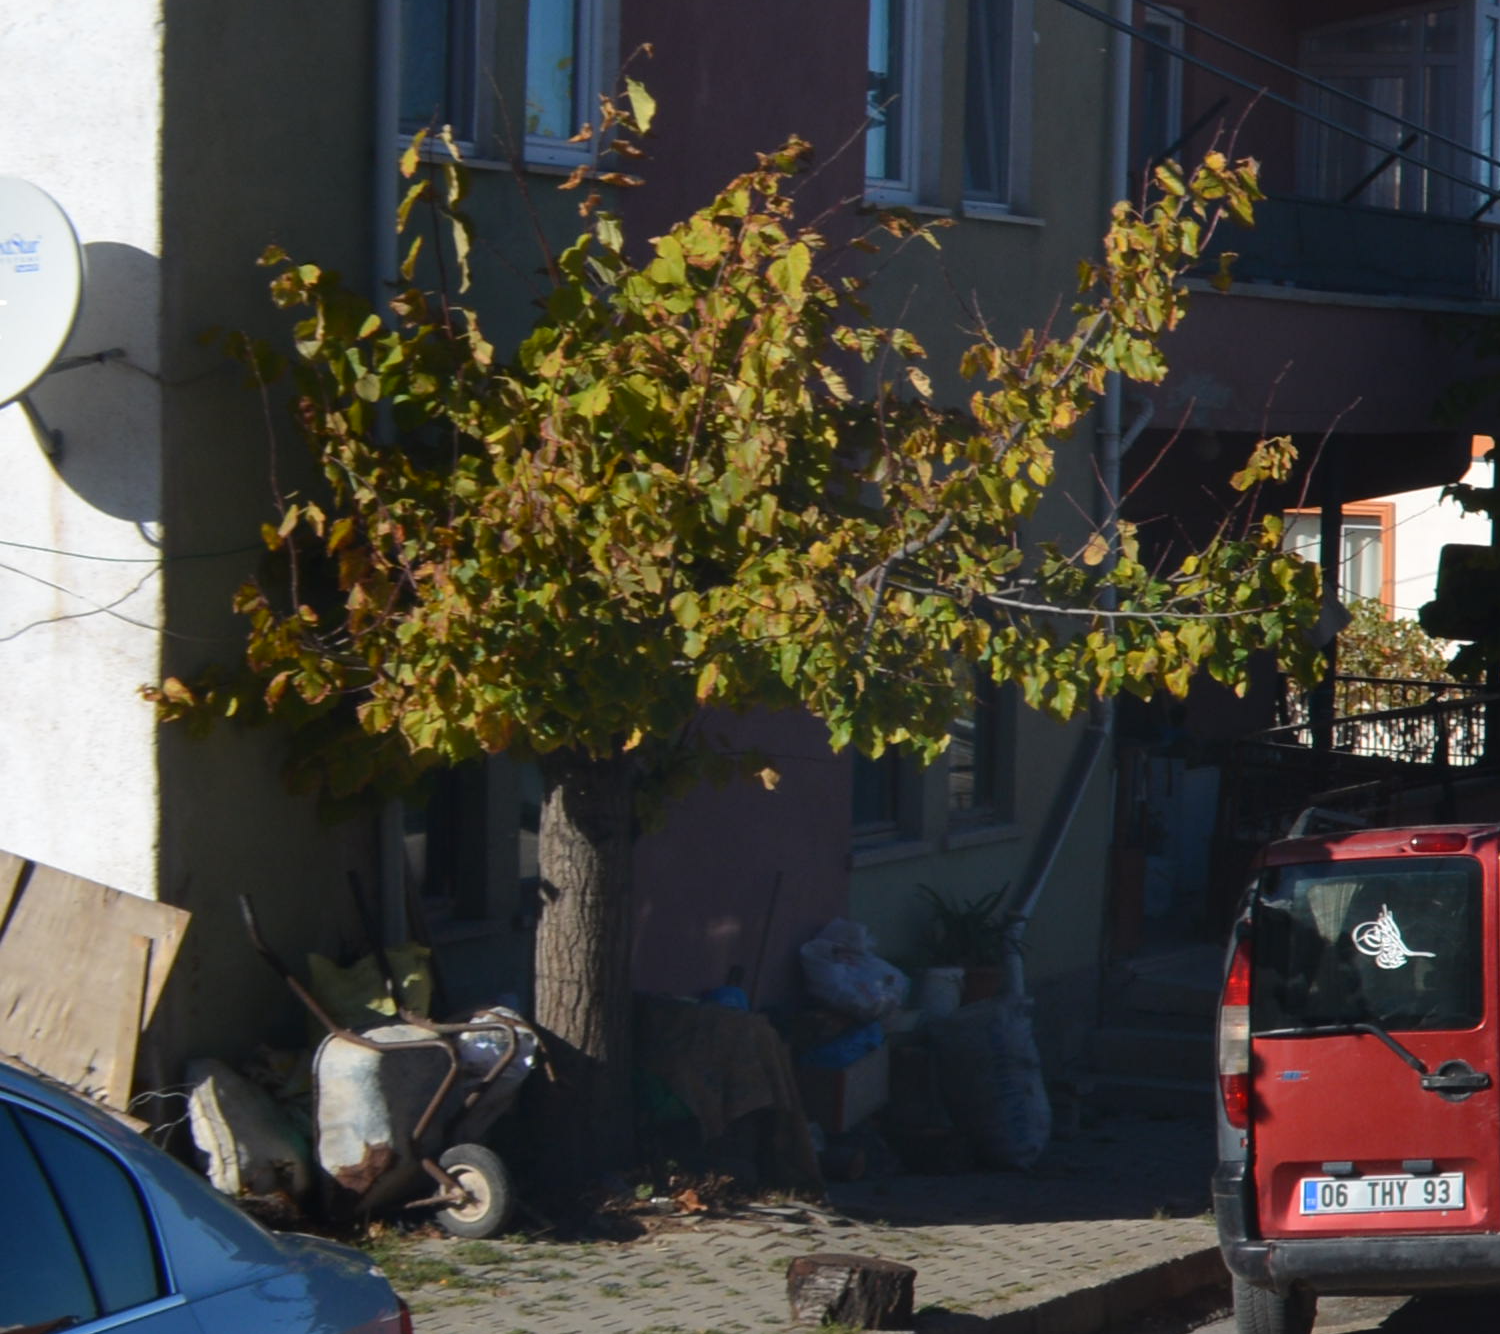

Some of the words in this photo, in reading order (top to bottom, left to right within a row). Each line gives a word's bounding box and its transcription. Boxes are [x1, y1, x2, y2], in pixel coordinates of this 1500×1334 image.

[1321, 1183, 1348, 1208] 06
[1367, 1181, 1409, 1206] THY
[1423, 1179, 1451, 1204] 93
